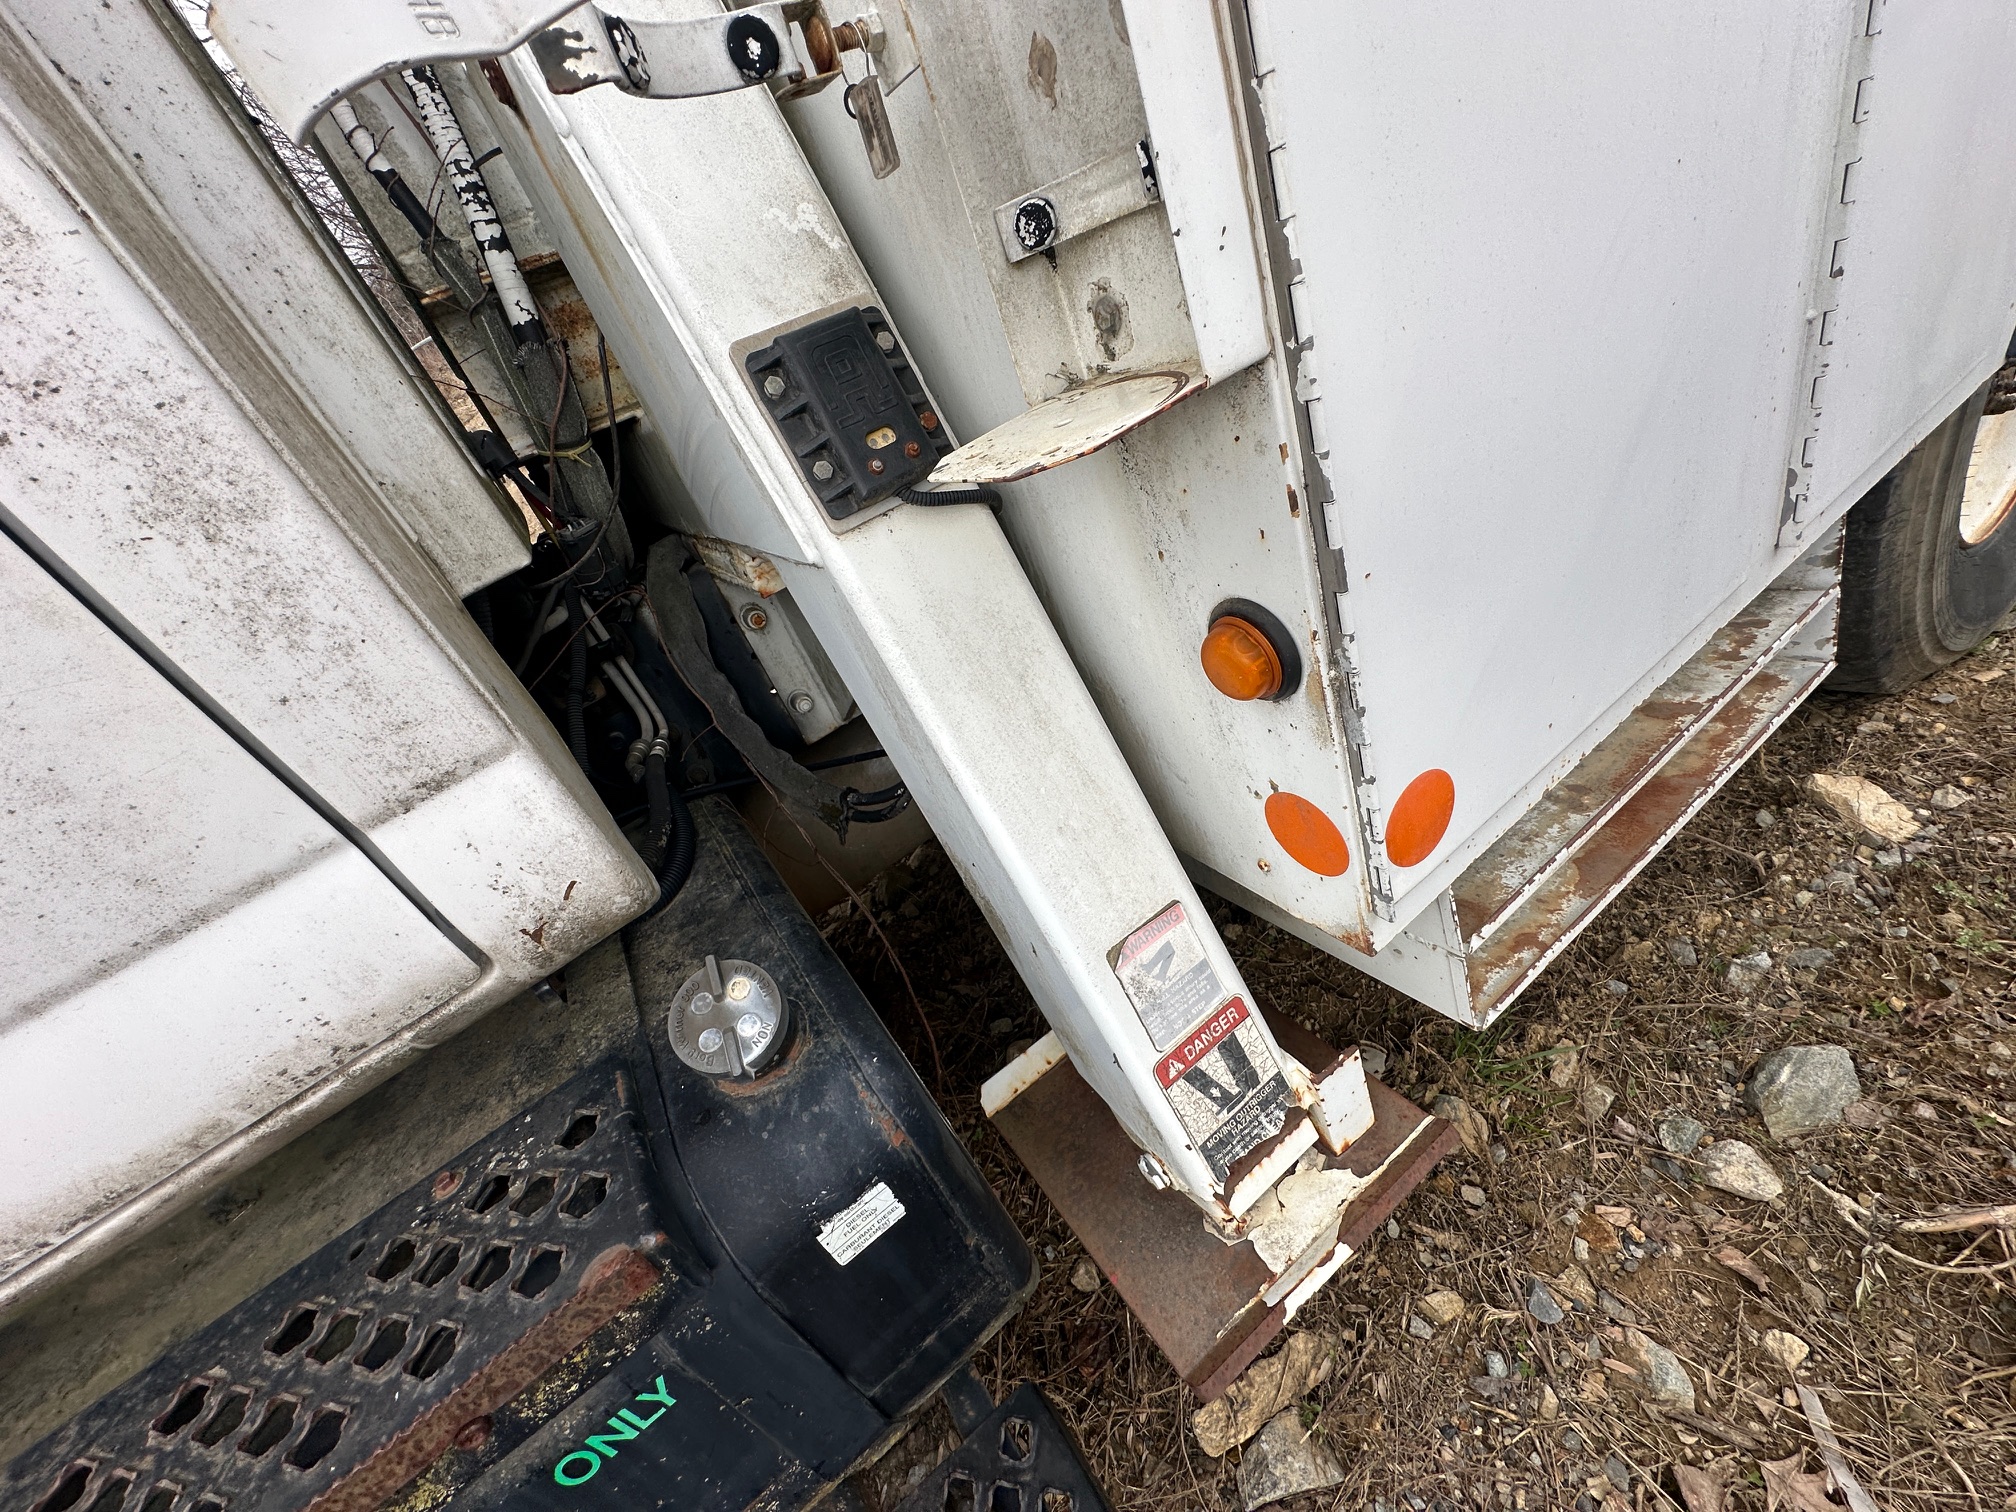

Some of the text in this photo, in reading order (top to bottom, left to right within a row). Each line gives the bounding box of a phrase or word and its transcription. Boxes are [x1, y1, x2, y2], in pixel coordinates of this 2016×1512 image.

[1126, 908, 1180, 954] WARNING
[751, 1021, 773, 1047] NON
[1182, 1006, 1240, 1061] DANGER
[1206, 1079, 1276, 1148] MOVING OUTRIGGER
[1231, 1104, 1261, 1136] HAZARD
[836, 1223, 876, 1258] CARBURANT
[876, 1204, 899, 1224] DIESEL
[842, 1220, 861, 1237] FUEL
[860, 1206, 877, 1222] ONLY
[845, 1206, 869, 1228] DIESEL
[852, 1217, 891, 1251] SEULEMENT
[554, 1374, 678, 1486] ONLY
